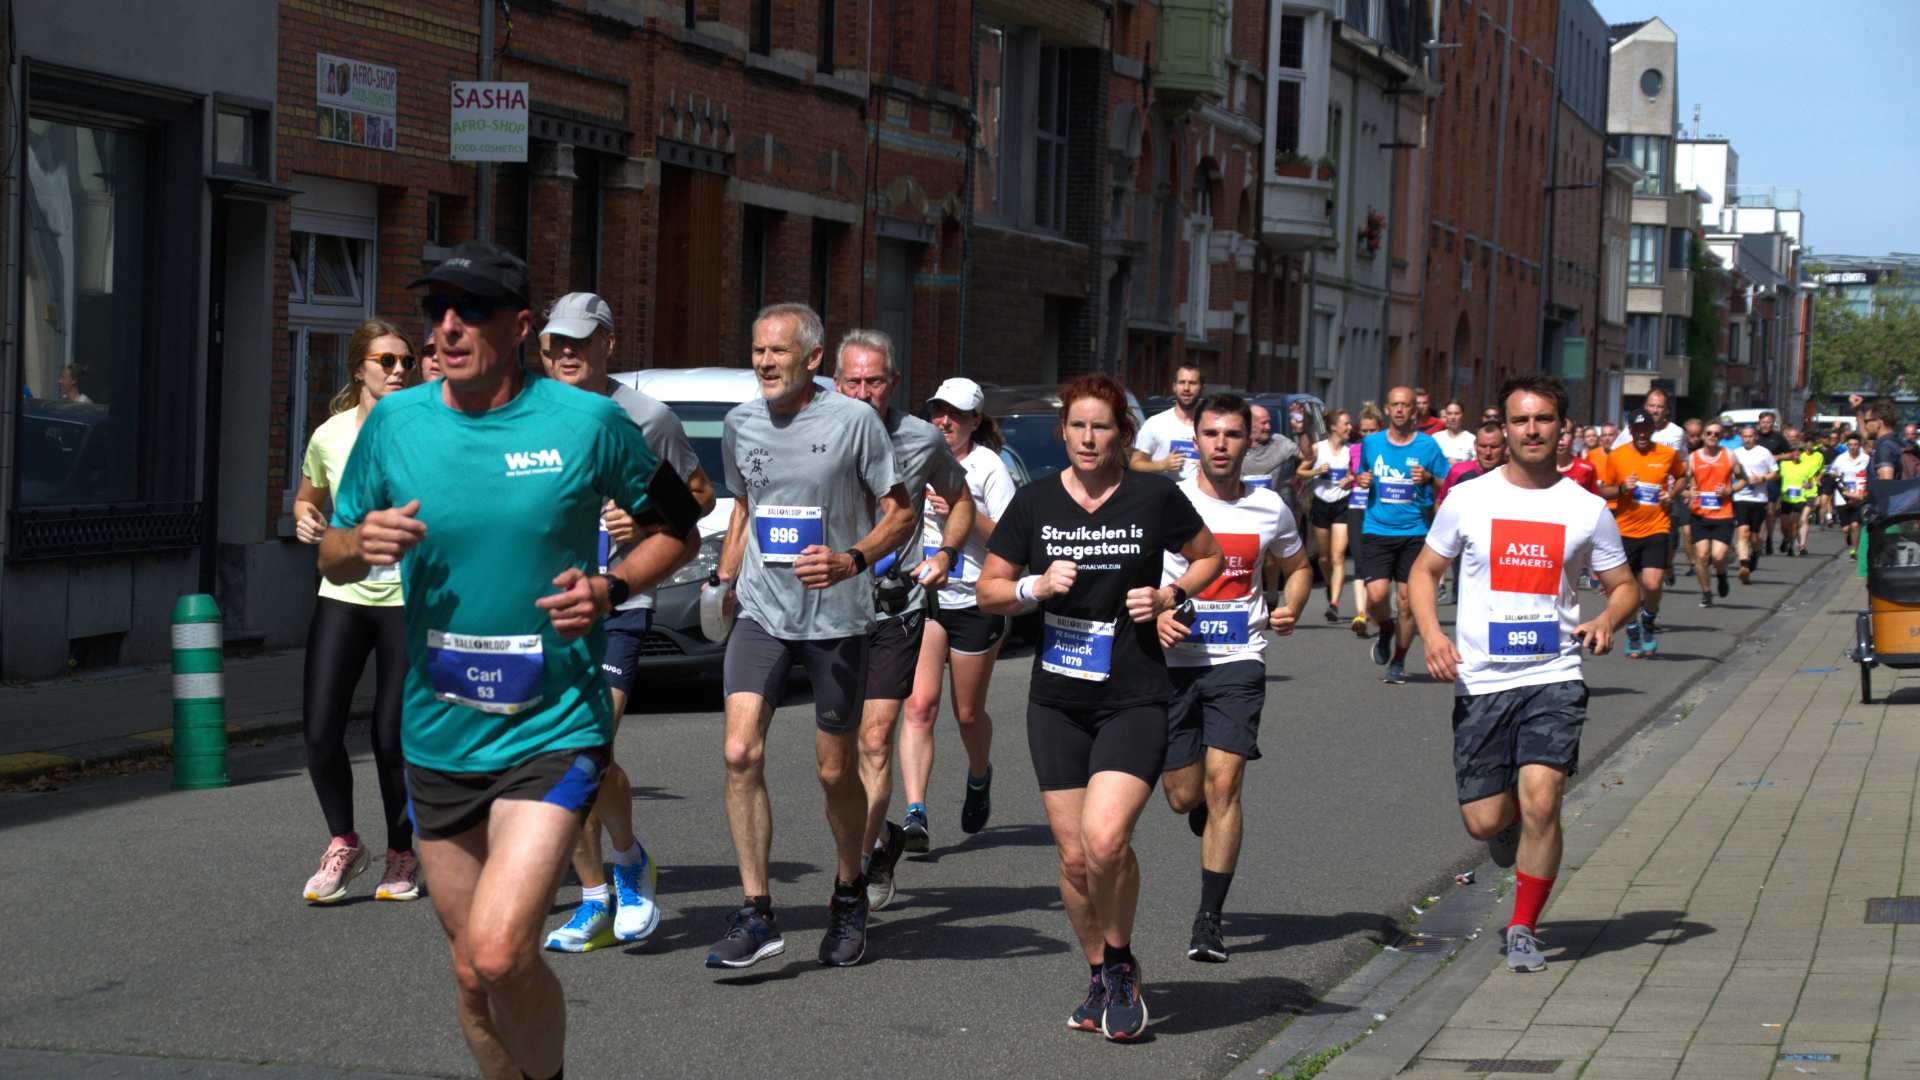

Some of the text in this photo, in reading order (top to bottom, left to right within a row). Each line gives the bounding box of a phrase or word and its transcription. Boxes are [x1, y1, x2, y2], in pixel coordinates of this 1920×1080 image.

[351, 64, 395, 91] AFRO-SHOP
[452, 88, 526, 109] SASHA
[453, 119, 525, 134] AFRO-SHOP
[769, 527, 799, 543] 996
[1041, 524, 1144, 540] Struikelen is
[1046, 542, 1140, 560] toegestaan
[1506, 542, 1549, 558] AXEL
[1077, 563, 1121, 571] NTAALWELZIJN
[1499, 556, 1554, 568] LENAERTS
[1200, 620, 1228, 635] 975
[1508, 631, 1538, 646] 959
[1054, 639, 1093, 656] Annick
[1061, 654, 1083, 667] 1079
[466, 666, 502, 683] Carl
[477, 686, 495, 699] 53
